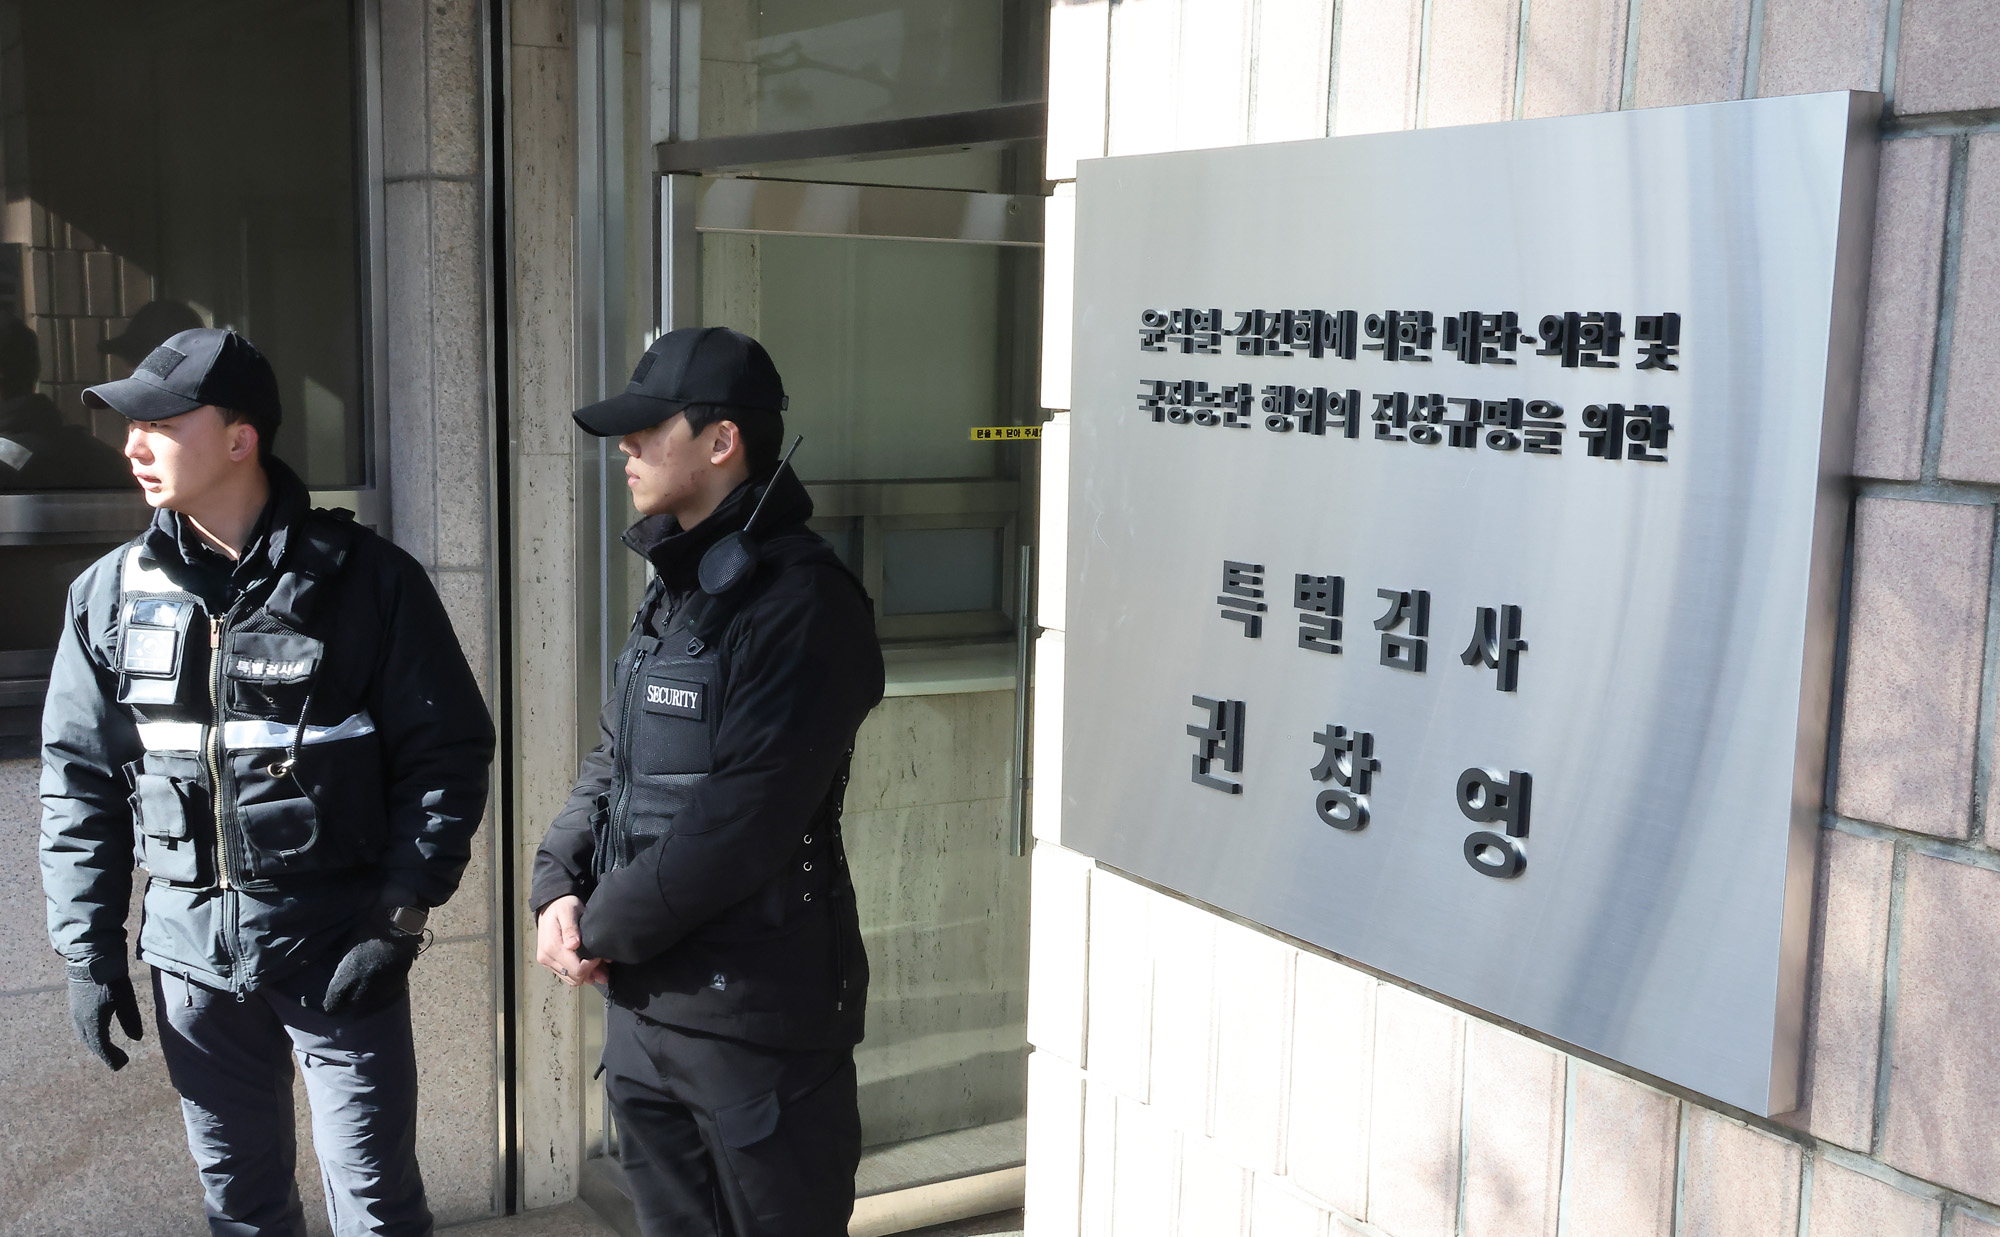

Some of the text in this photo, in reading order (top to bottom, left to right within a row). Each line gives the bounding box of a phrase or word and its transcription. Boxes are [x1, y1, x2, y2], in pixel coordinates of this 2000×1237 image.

[1362, 310, 1437, 362] 의한
[1635, 312, 1681, 371] 및
[977, 429, 991, 439] 문을
[1006, 429, 1021, 438] 닫아
[1137, 379, 1674, 463] 국정농단 행위의 진상규명을 위한
[647, 684, 698, 709] SECURITY
